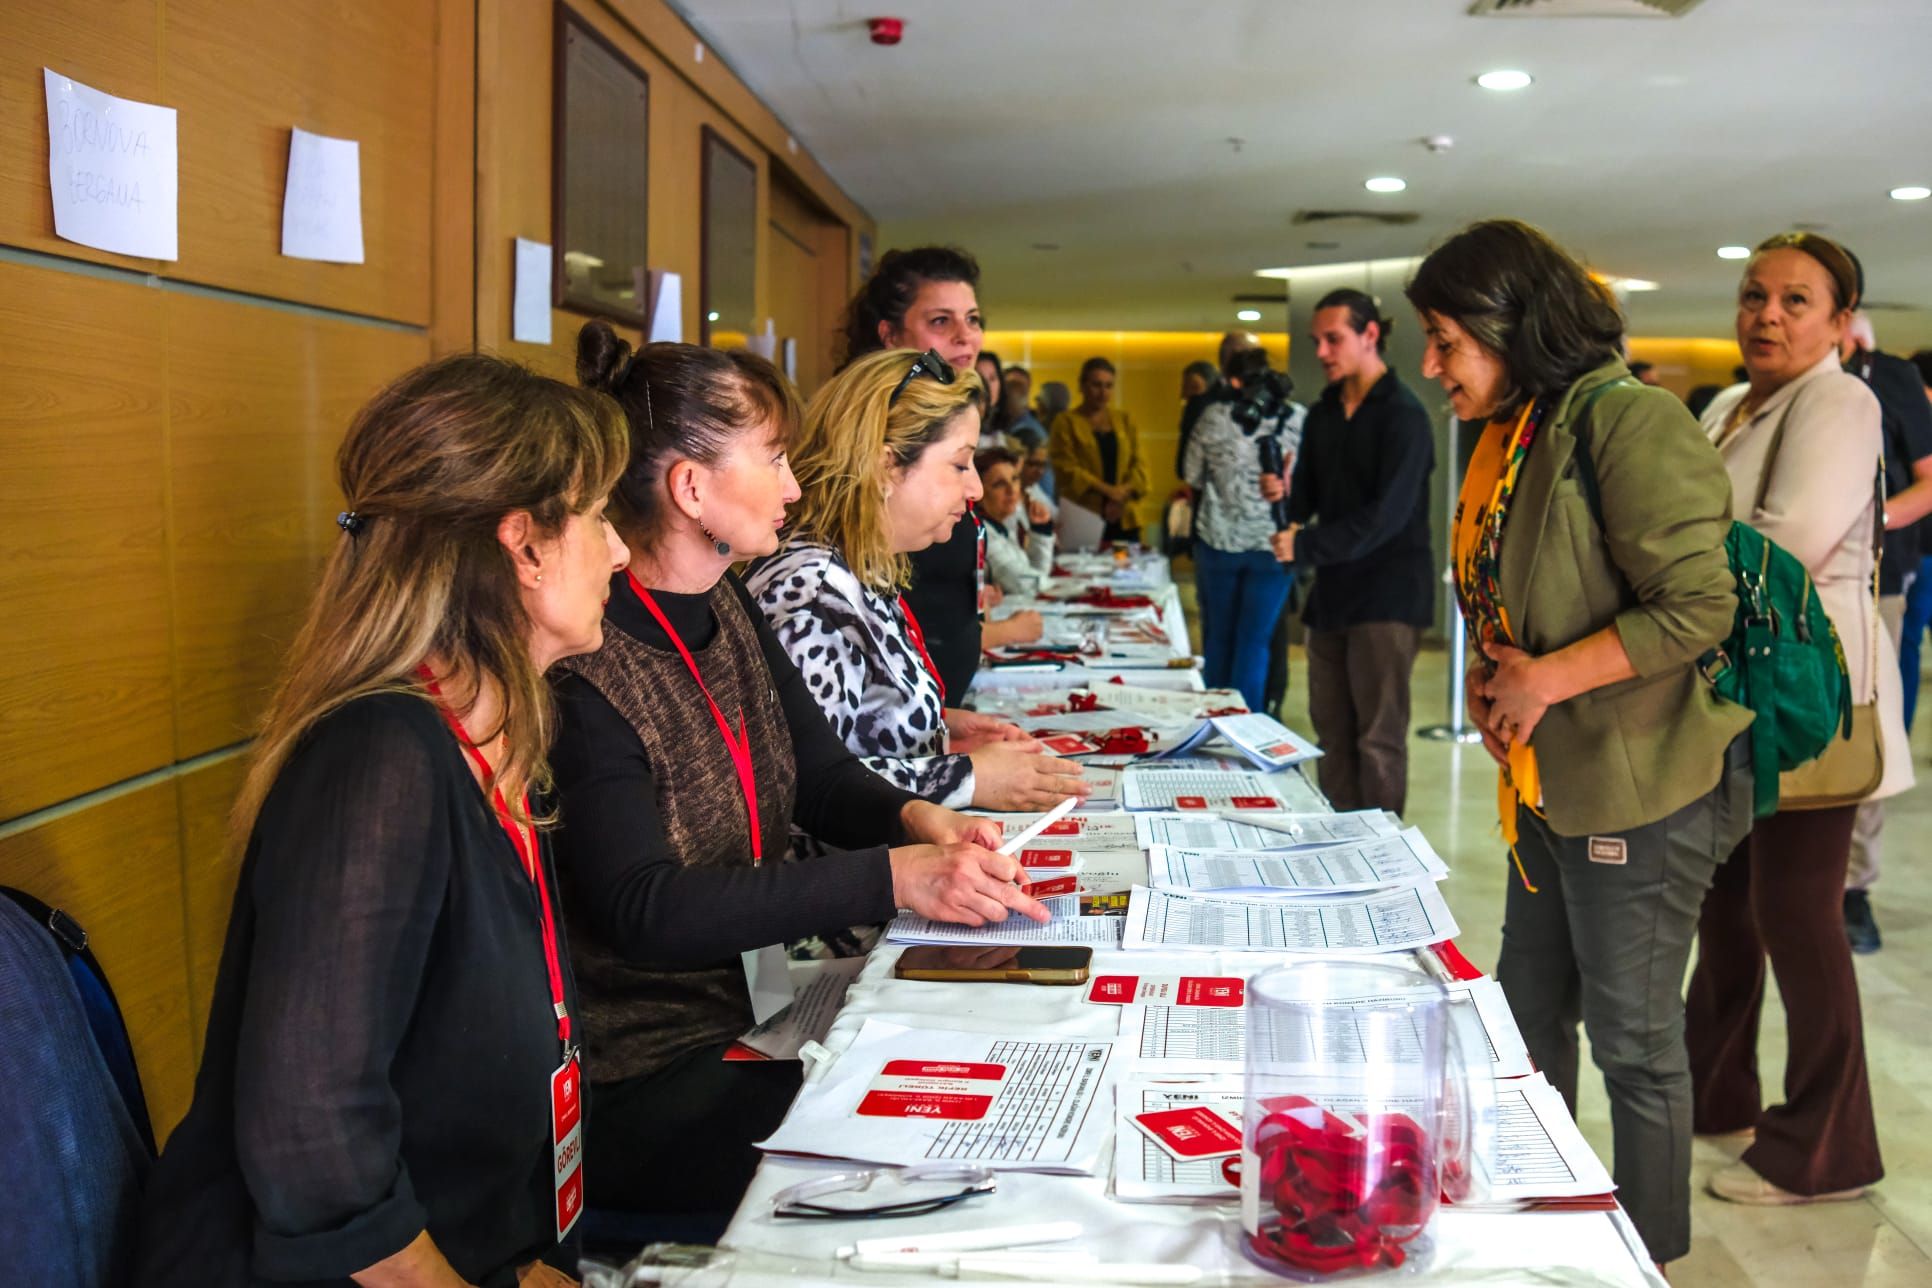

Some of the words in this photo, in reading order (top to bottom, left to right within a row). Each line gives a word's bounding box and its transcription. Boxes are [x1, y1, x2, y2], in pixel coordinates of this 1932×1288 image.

[1162, 892, 1187, 900] YENI
[1163, 1093, 1199, 1101] YENI
[904, 1104, 942, 1114] YENI
